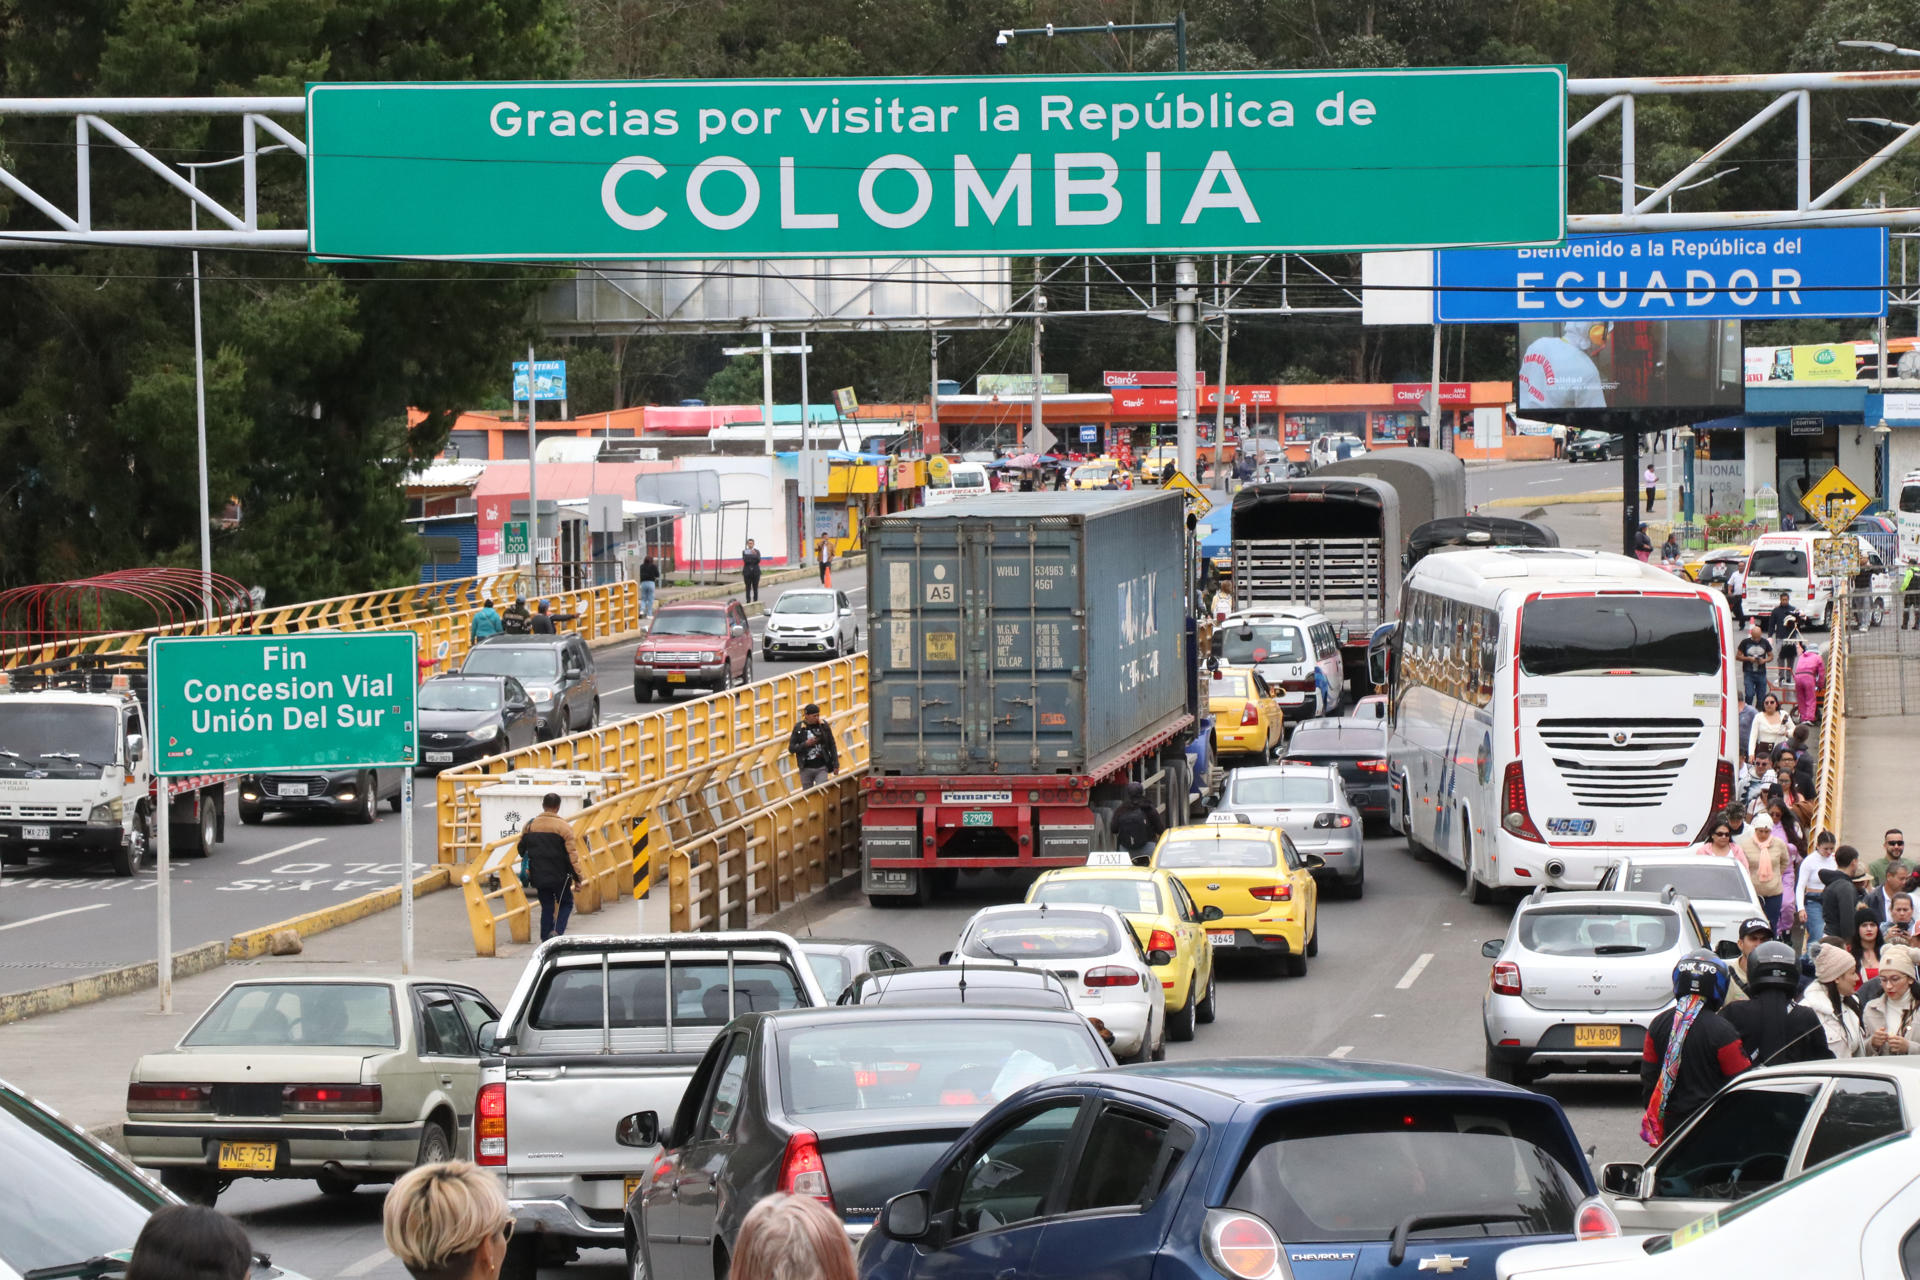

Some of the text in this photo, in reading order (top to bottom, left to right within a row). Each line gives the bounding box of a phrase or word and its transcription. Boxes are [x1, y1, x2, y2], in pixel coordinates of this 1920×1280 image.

[489, 90, 1377, 144] Gracias por visitar la República de
[601, 150, 1261, 231] COLOMBIA
[1630, 244, 1642, 257] a
[1647, 239, 1665, 256] la
[1671, 238, 1767, 261] República
[1772, 237, 1802, 255] del
[1516, 268, 1803, 310] ECUADOR
[1106, 375, 1133, 385] Claro
[1397, 391, 1421, 399] Claro
[1122, 399, 1141, 407] Claro
[507, 544, 526, 553] 000
[996, 566, 1020, 577] WHLU
[1034, 566, 1064, 576] 534963
[1034, 579, 1053, 590] 45G1
[930, 586, 951, 600] A5
[996, 623, 1020, 635] M.G.W.
[997, 635, 1014, 646] TARE
[263, 646, 307, 671] Fin
[1291, 666, 1303, 676] 01
[183, 673, 393, 703] Concesion Vial
[192, 703, 386, 733] Unión Del Sur
[943, 793, 1010, 801] romarco
[970, 812, 993, 824] 29029
[1097, 854, 1121, 865] TAXI
[1700, 964, 1718, 975] 17G
[1291, 1252, 1356, 1262] CHEVROLET
